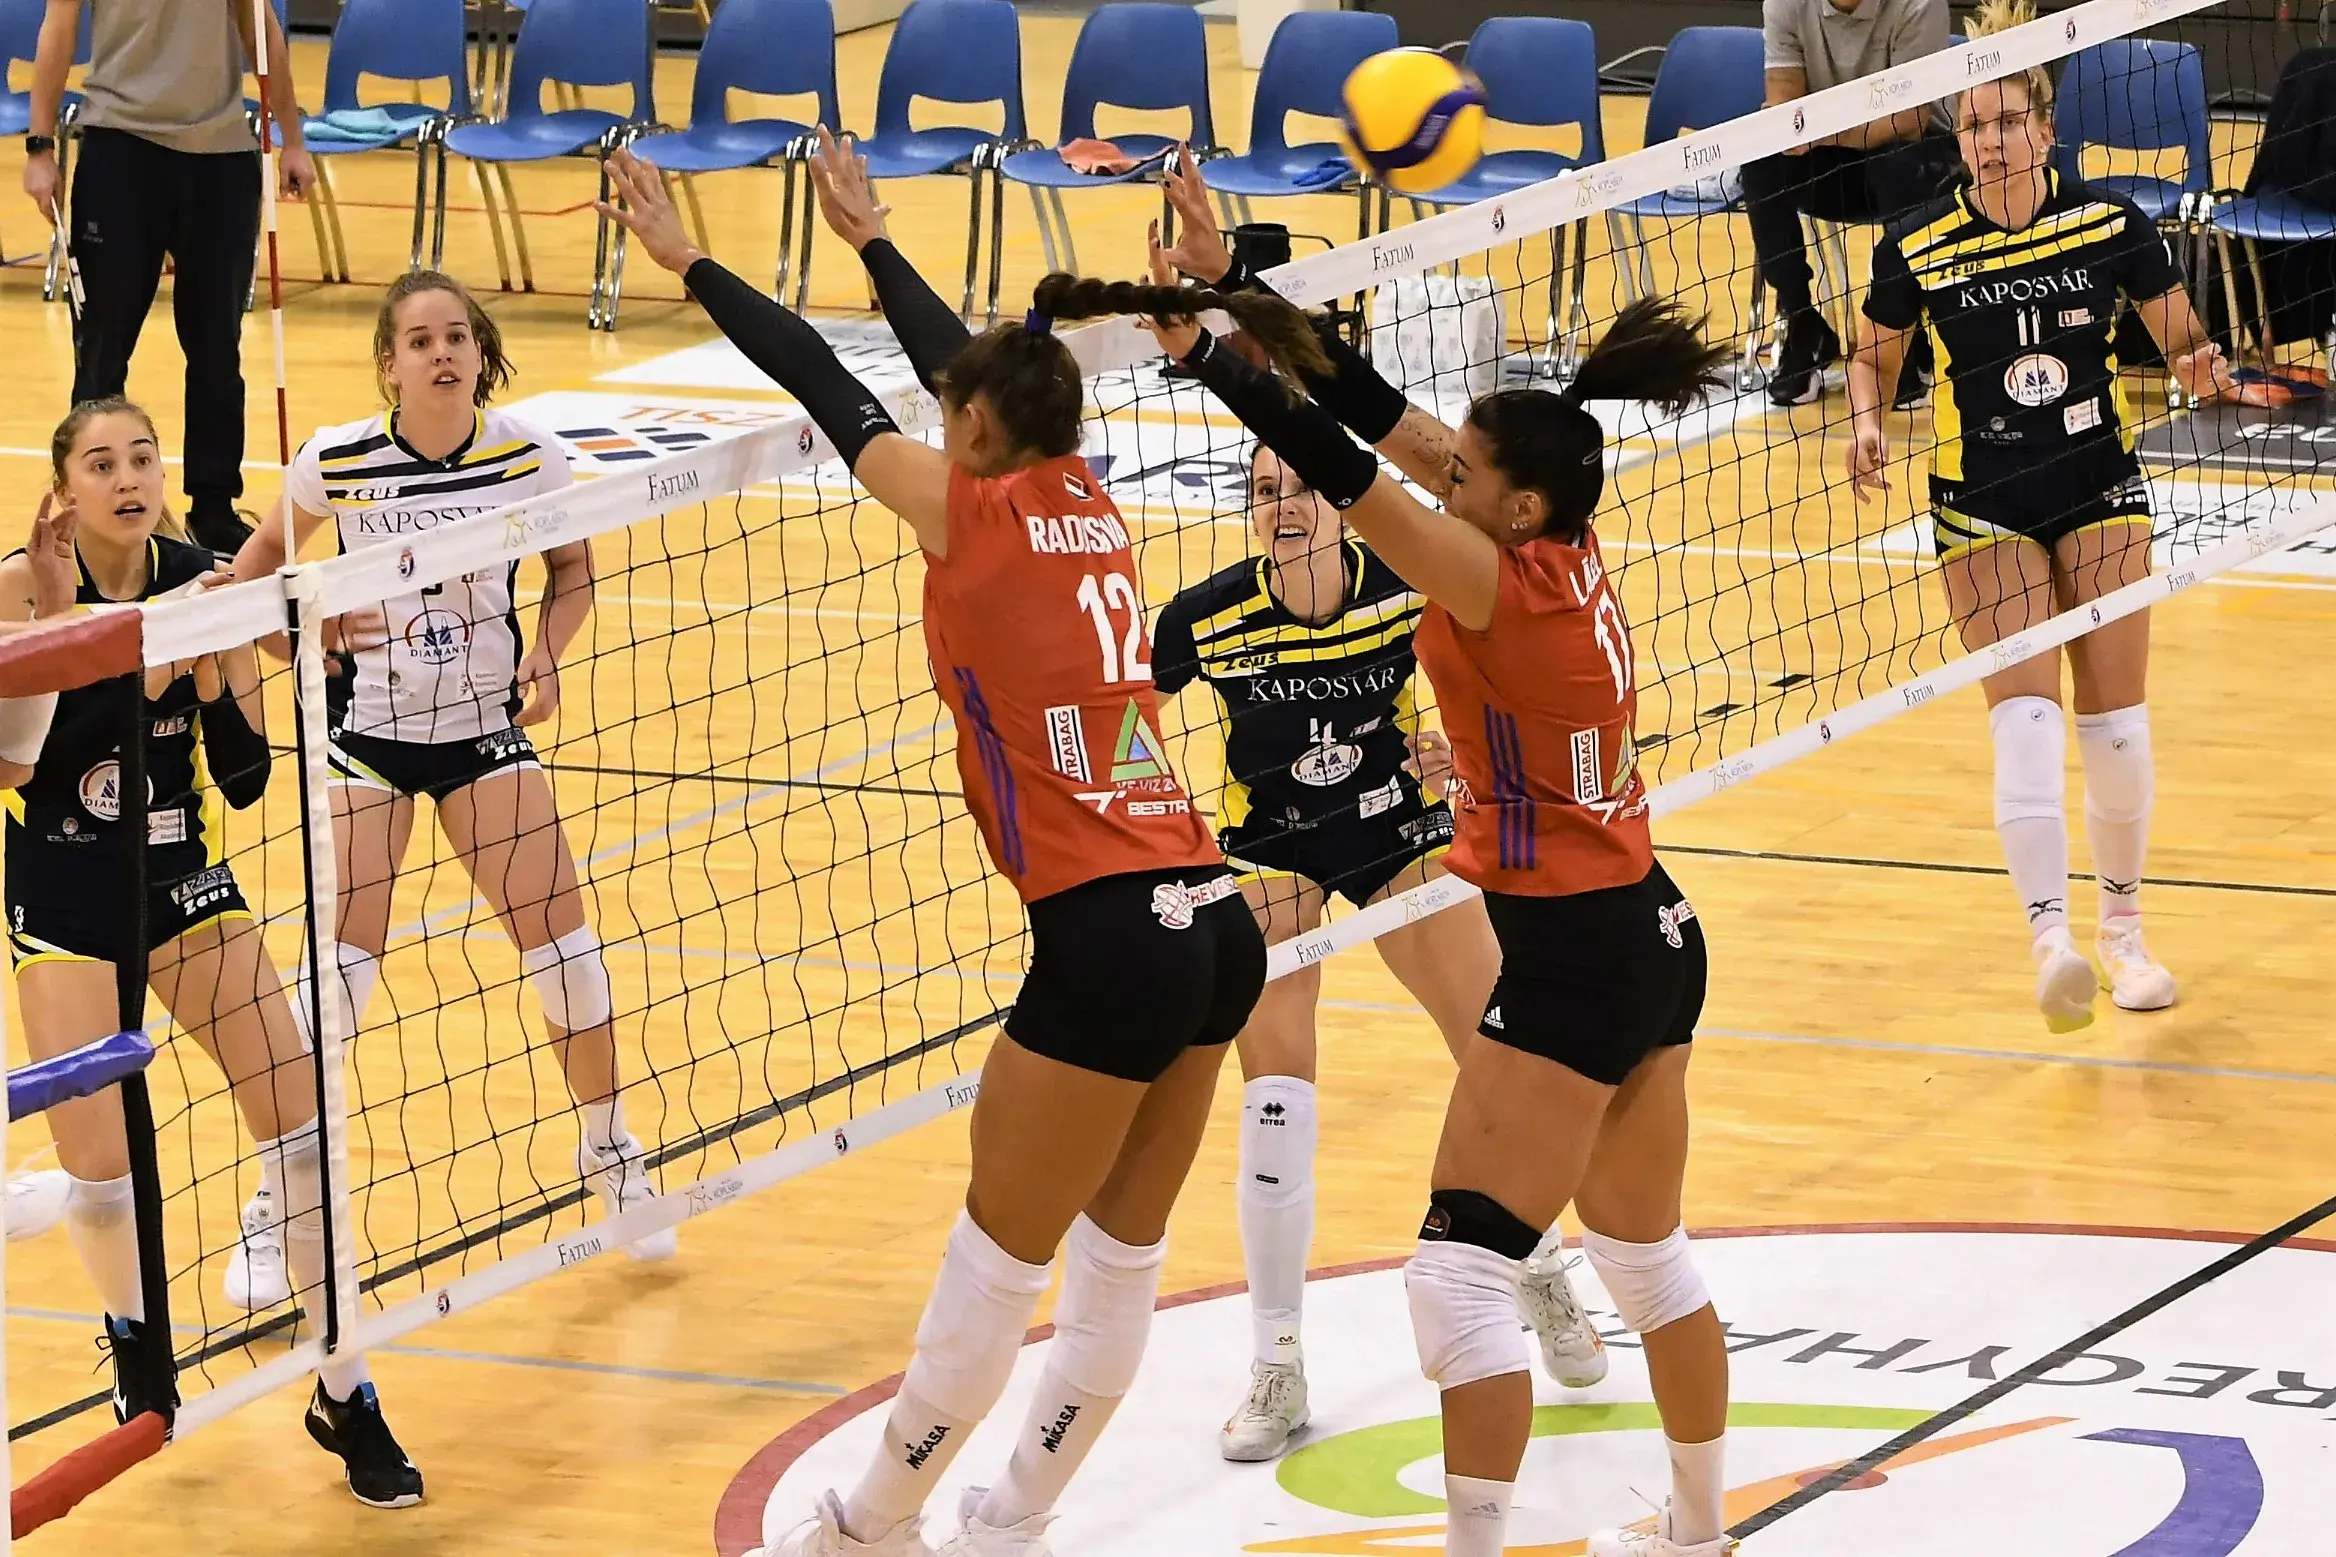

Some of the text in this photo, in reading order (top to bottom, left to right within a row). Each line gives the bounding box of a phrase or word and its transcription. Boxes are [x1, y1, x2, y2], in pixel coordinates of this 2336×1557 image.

[1960, 267, 2093, 307] KAPOSVÁR
[2016, 305, 2041, 346] 11
[359, 507, 497, 533] KAPOS
[1076, 572, 1152, 684] 12
[1248, 667, 1395, 702] KAPOSVÁR
[493, 741, 533, 760] Zeu
[1058, 710, 1080, 779] TRABAG
[1309, 717, 1337, 745] 4
[1581, 733, 1595, 798] STRABAG
[85, 798, 119, 809] DIAM
[945, 1083, 979, 1108] FATU
[905, 1425, 951, 1470] MIKASA
[1041, 1404, 1081, 1453] MIKASA
